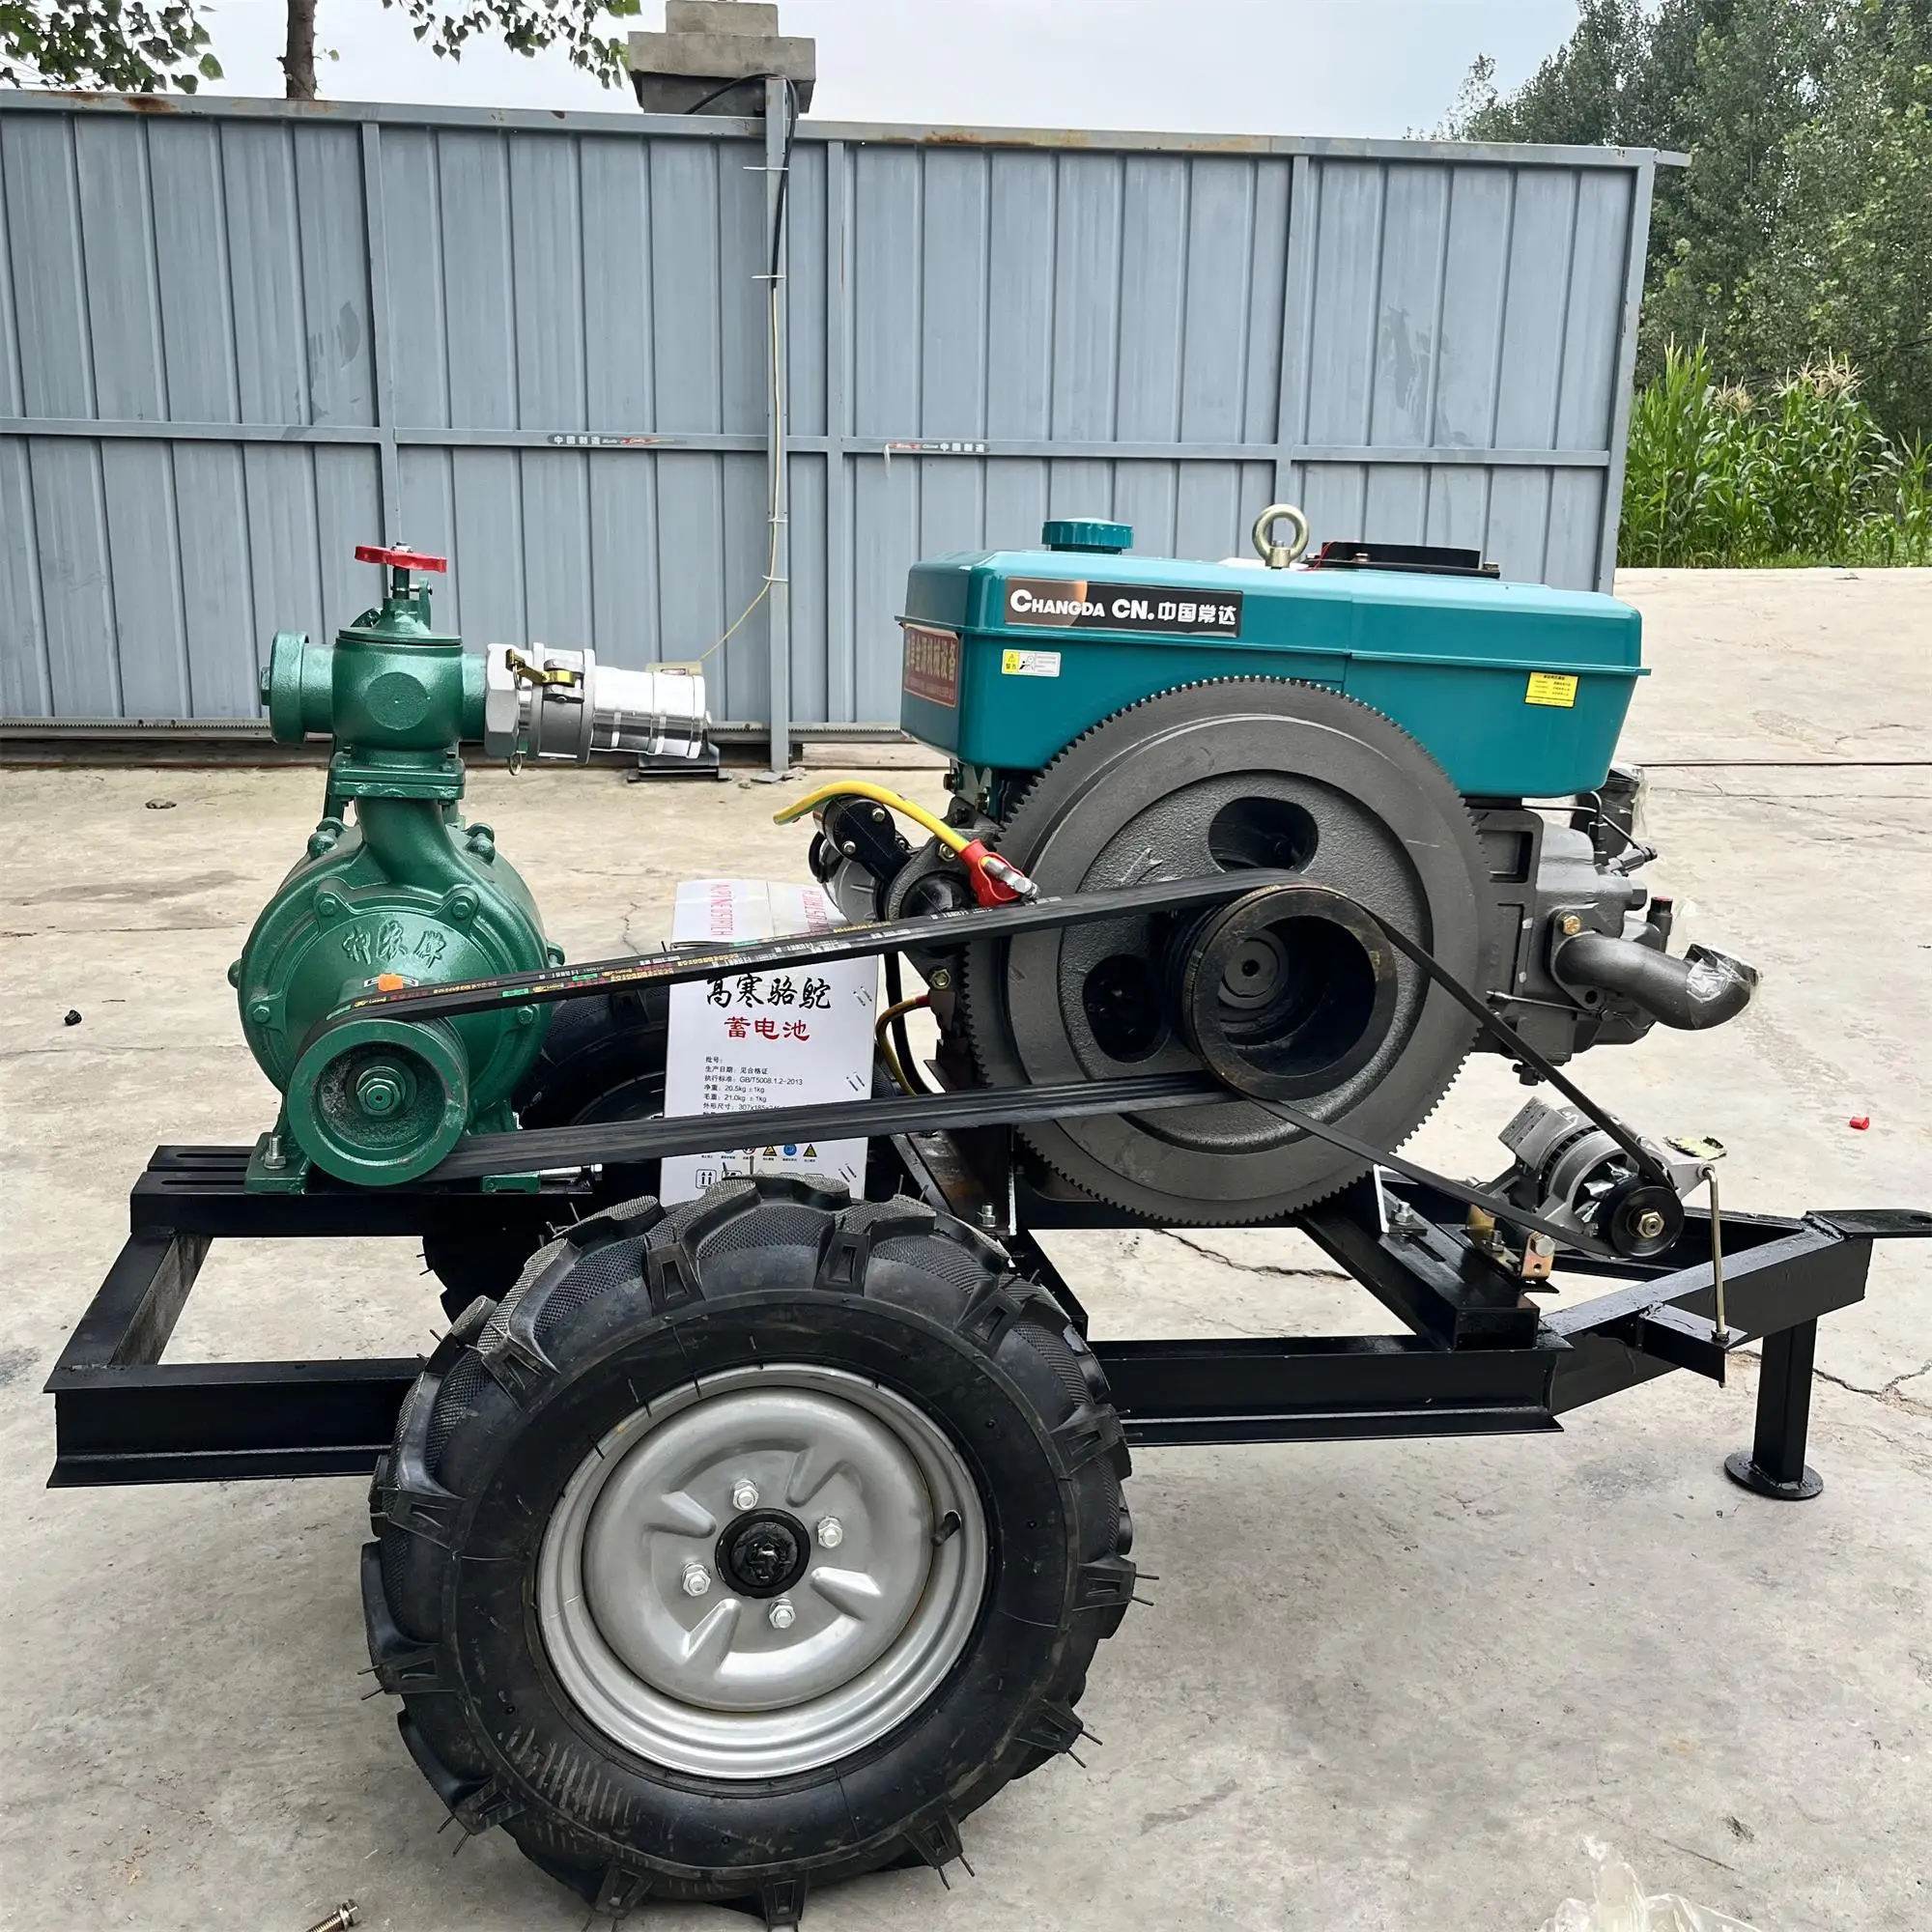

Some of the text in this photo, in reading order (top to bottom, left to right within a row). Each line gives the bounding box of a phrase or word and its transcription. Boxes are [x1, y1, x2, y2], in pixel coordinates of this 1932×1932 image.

[1010, 589, 1105, 617] CHANGDA
[1157, 602, 1236, 625] 中国常达
[724, 1016, 810, 1041] 蓄电池
